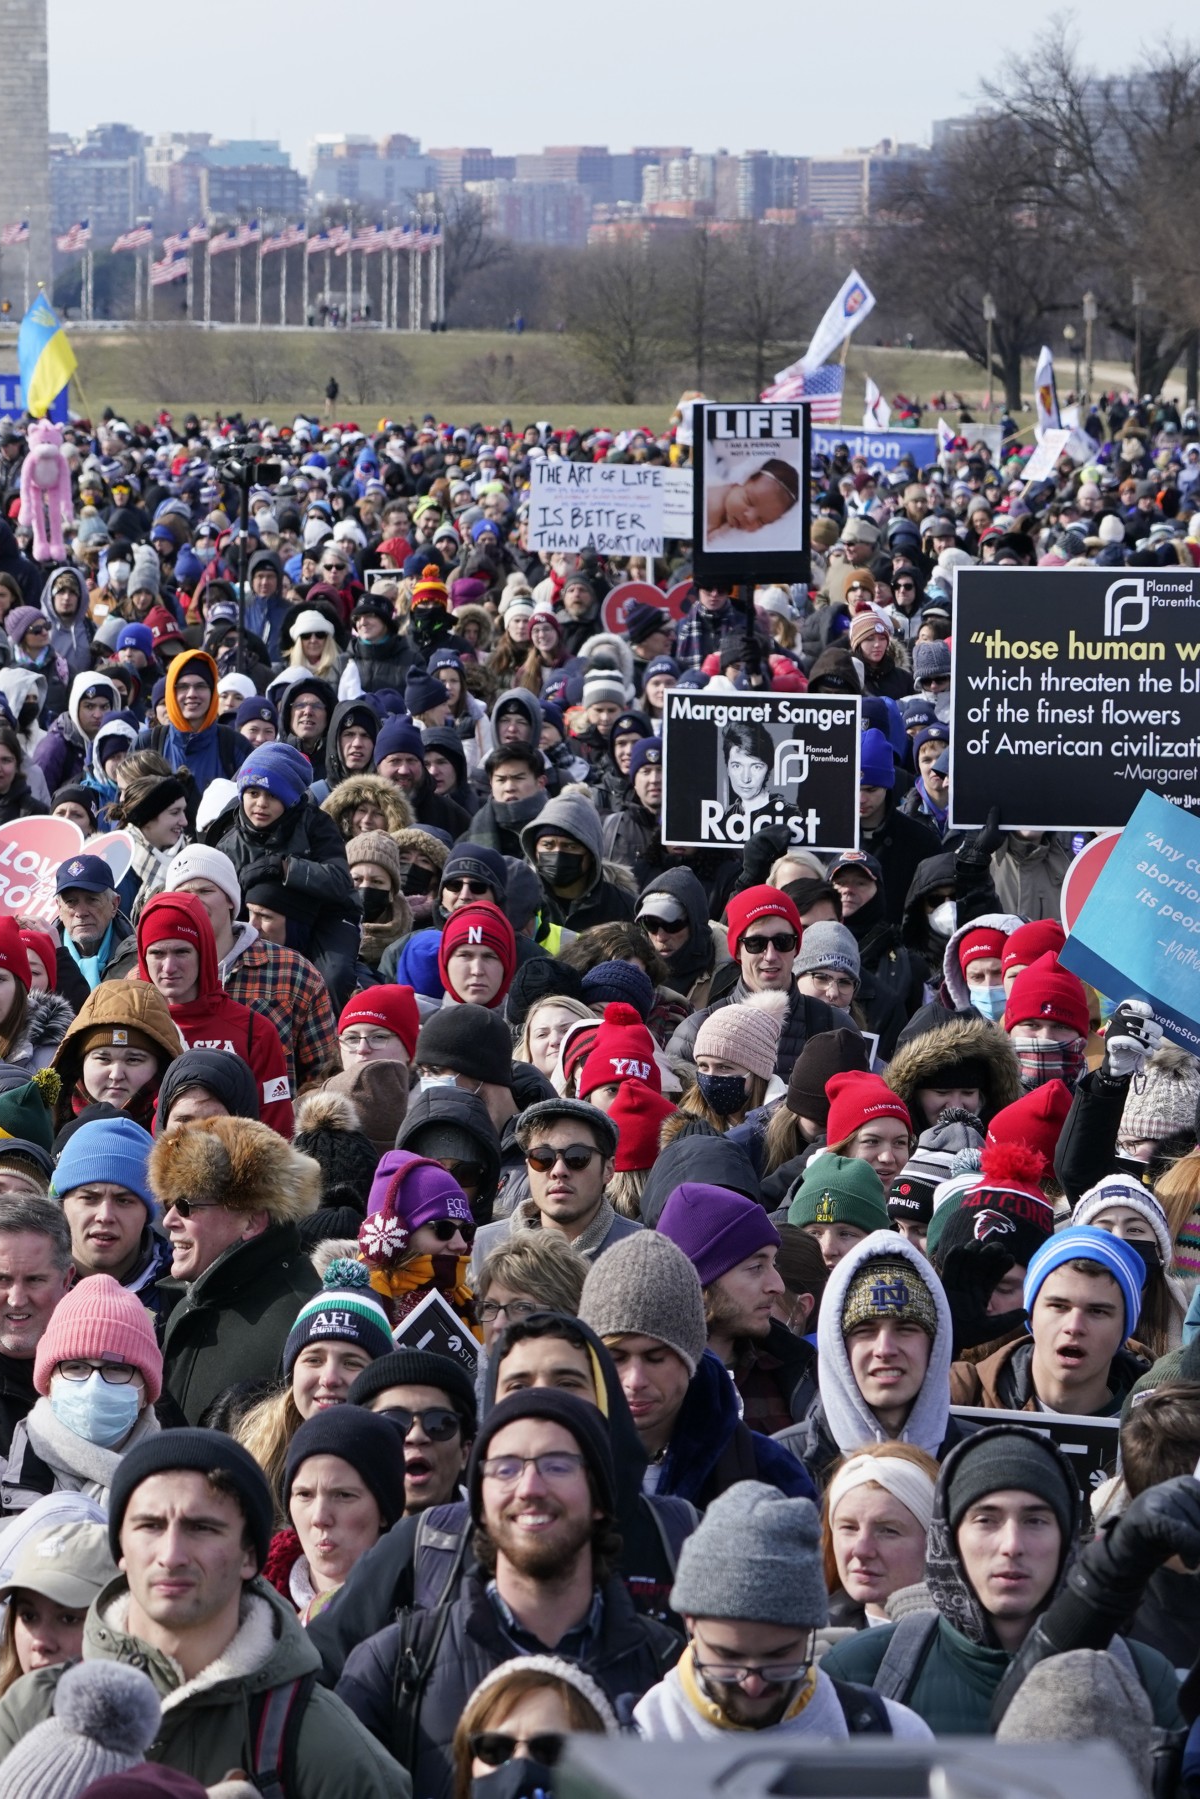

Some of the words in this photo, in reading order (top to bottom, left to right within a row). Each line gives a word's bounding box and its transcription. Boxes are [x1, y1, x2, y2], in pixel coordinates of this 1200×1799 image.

[715, 410, 793, 438] LIFE
[536, 463, 563, 485] THE
[567, 463, 593, 487] ART
[601, 470, 616, 481] OF
[622, 469, 663, 487] LIFE
[538, 507, 563, 528] IS
[571, 507, 646, 530] BETTER
[534, 530, 579, 548] THAN
[587, 532, 662, 553] ABORTION
[1146, 580, 1193, 592] Planned
[1068, 630, 1165, 661] human
[968, 666, 1032, 692] which
[1040, 666, 1130, 693] threaten
[1138, 667, 1173, 693] the
[670, 696, 772, 727] Margaret
[777, 701, 855, 731] Sanger
[967, 698, 990, 723] of
[997, 698, 1030, 723] the
[1037, 698, 1095, 724] finest
[1102, 699, 1181, 725] flowers
[805, 745, 832, 754] Planned
[966, 729, 989, 755] of
[995, 732, 1103, 757] American
[810, 755, 849, 763] Parenthood
[701, 799, 821, 844] Racist
[1135, 887, 1159, 908] its
[468, 926, 482, 944] N
[961, 1192, 1053, 1233] FALCONS
[311, 1312, 357, 1328] AFL
